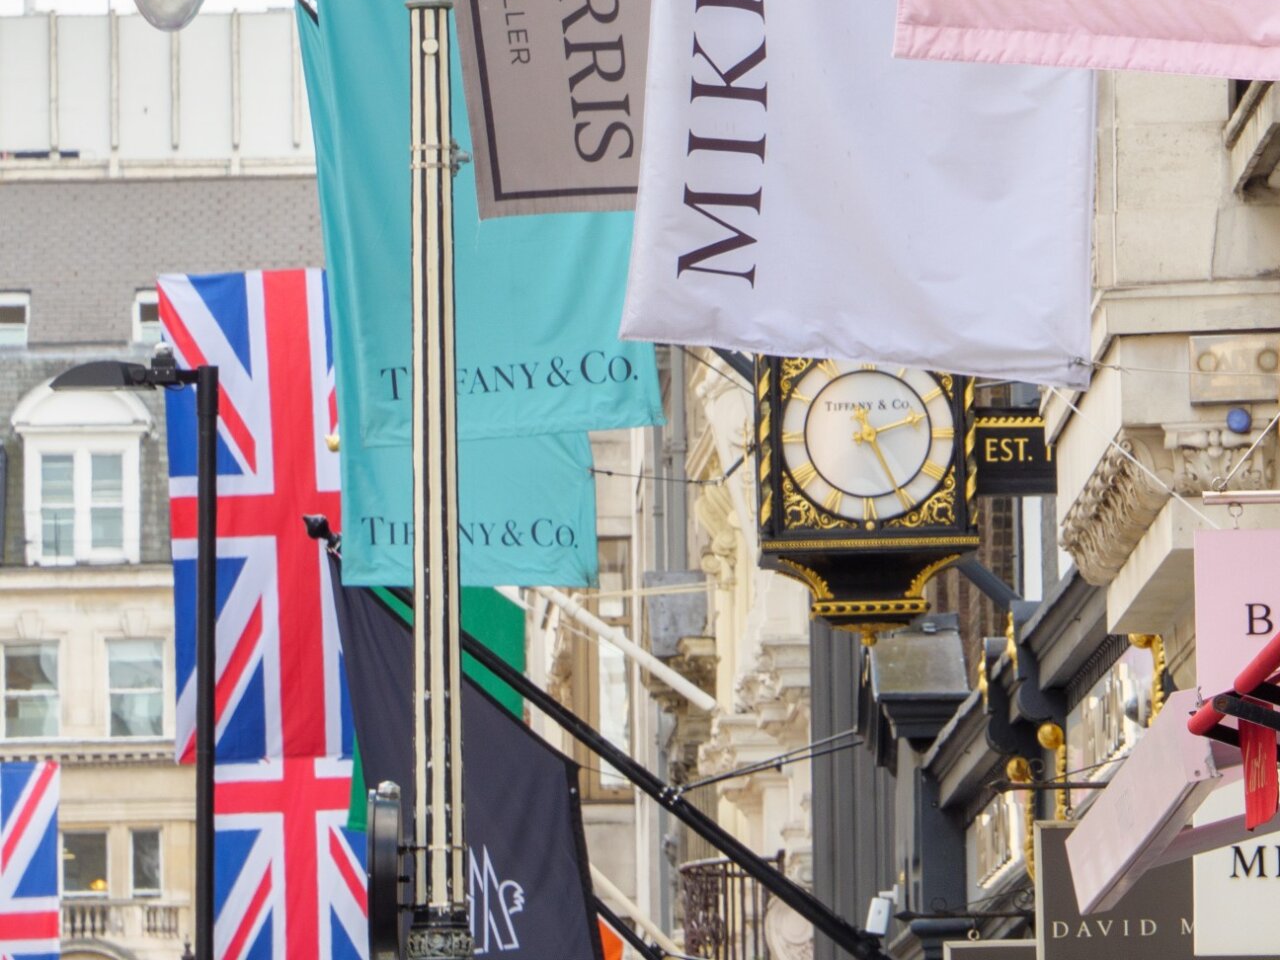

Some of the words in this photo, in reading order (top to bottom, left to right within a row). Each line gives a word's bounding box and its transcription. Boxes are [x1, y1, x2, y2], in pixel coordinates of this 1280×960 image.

[380, 362, 539, 401] TFANY
[985, 437, 1033, 462] EST.
[361, 516, 496, 546] TIFNY
[1052, 919, 1158, 938] DAVID
